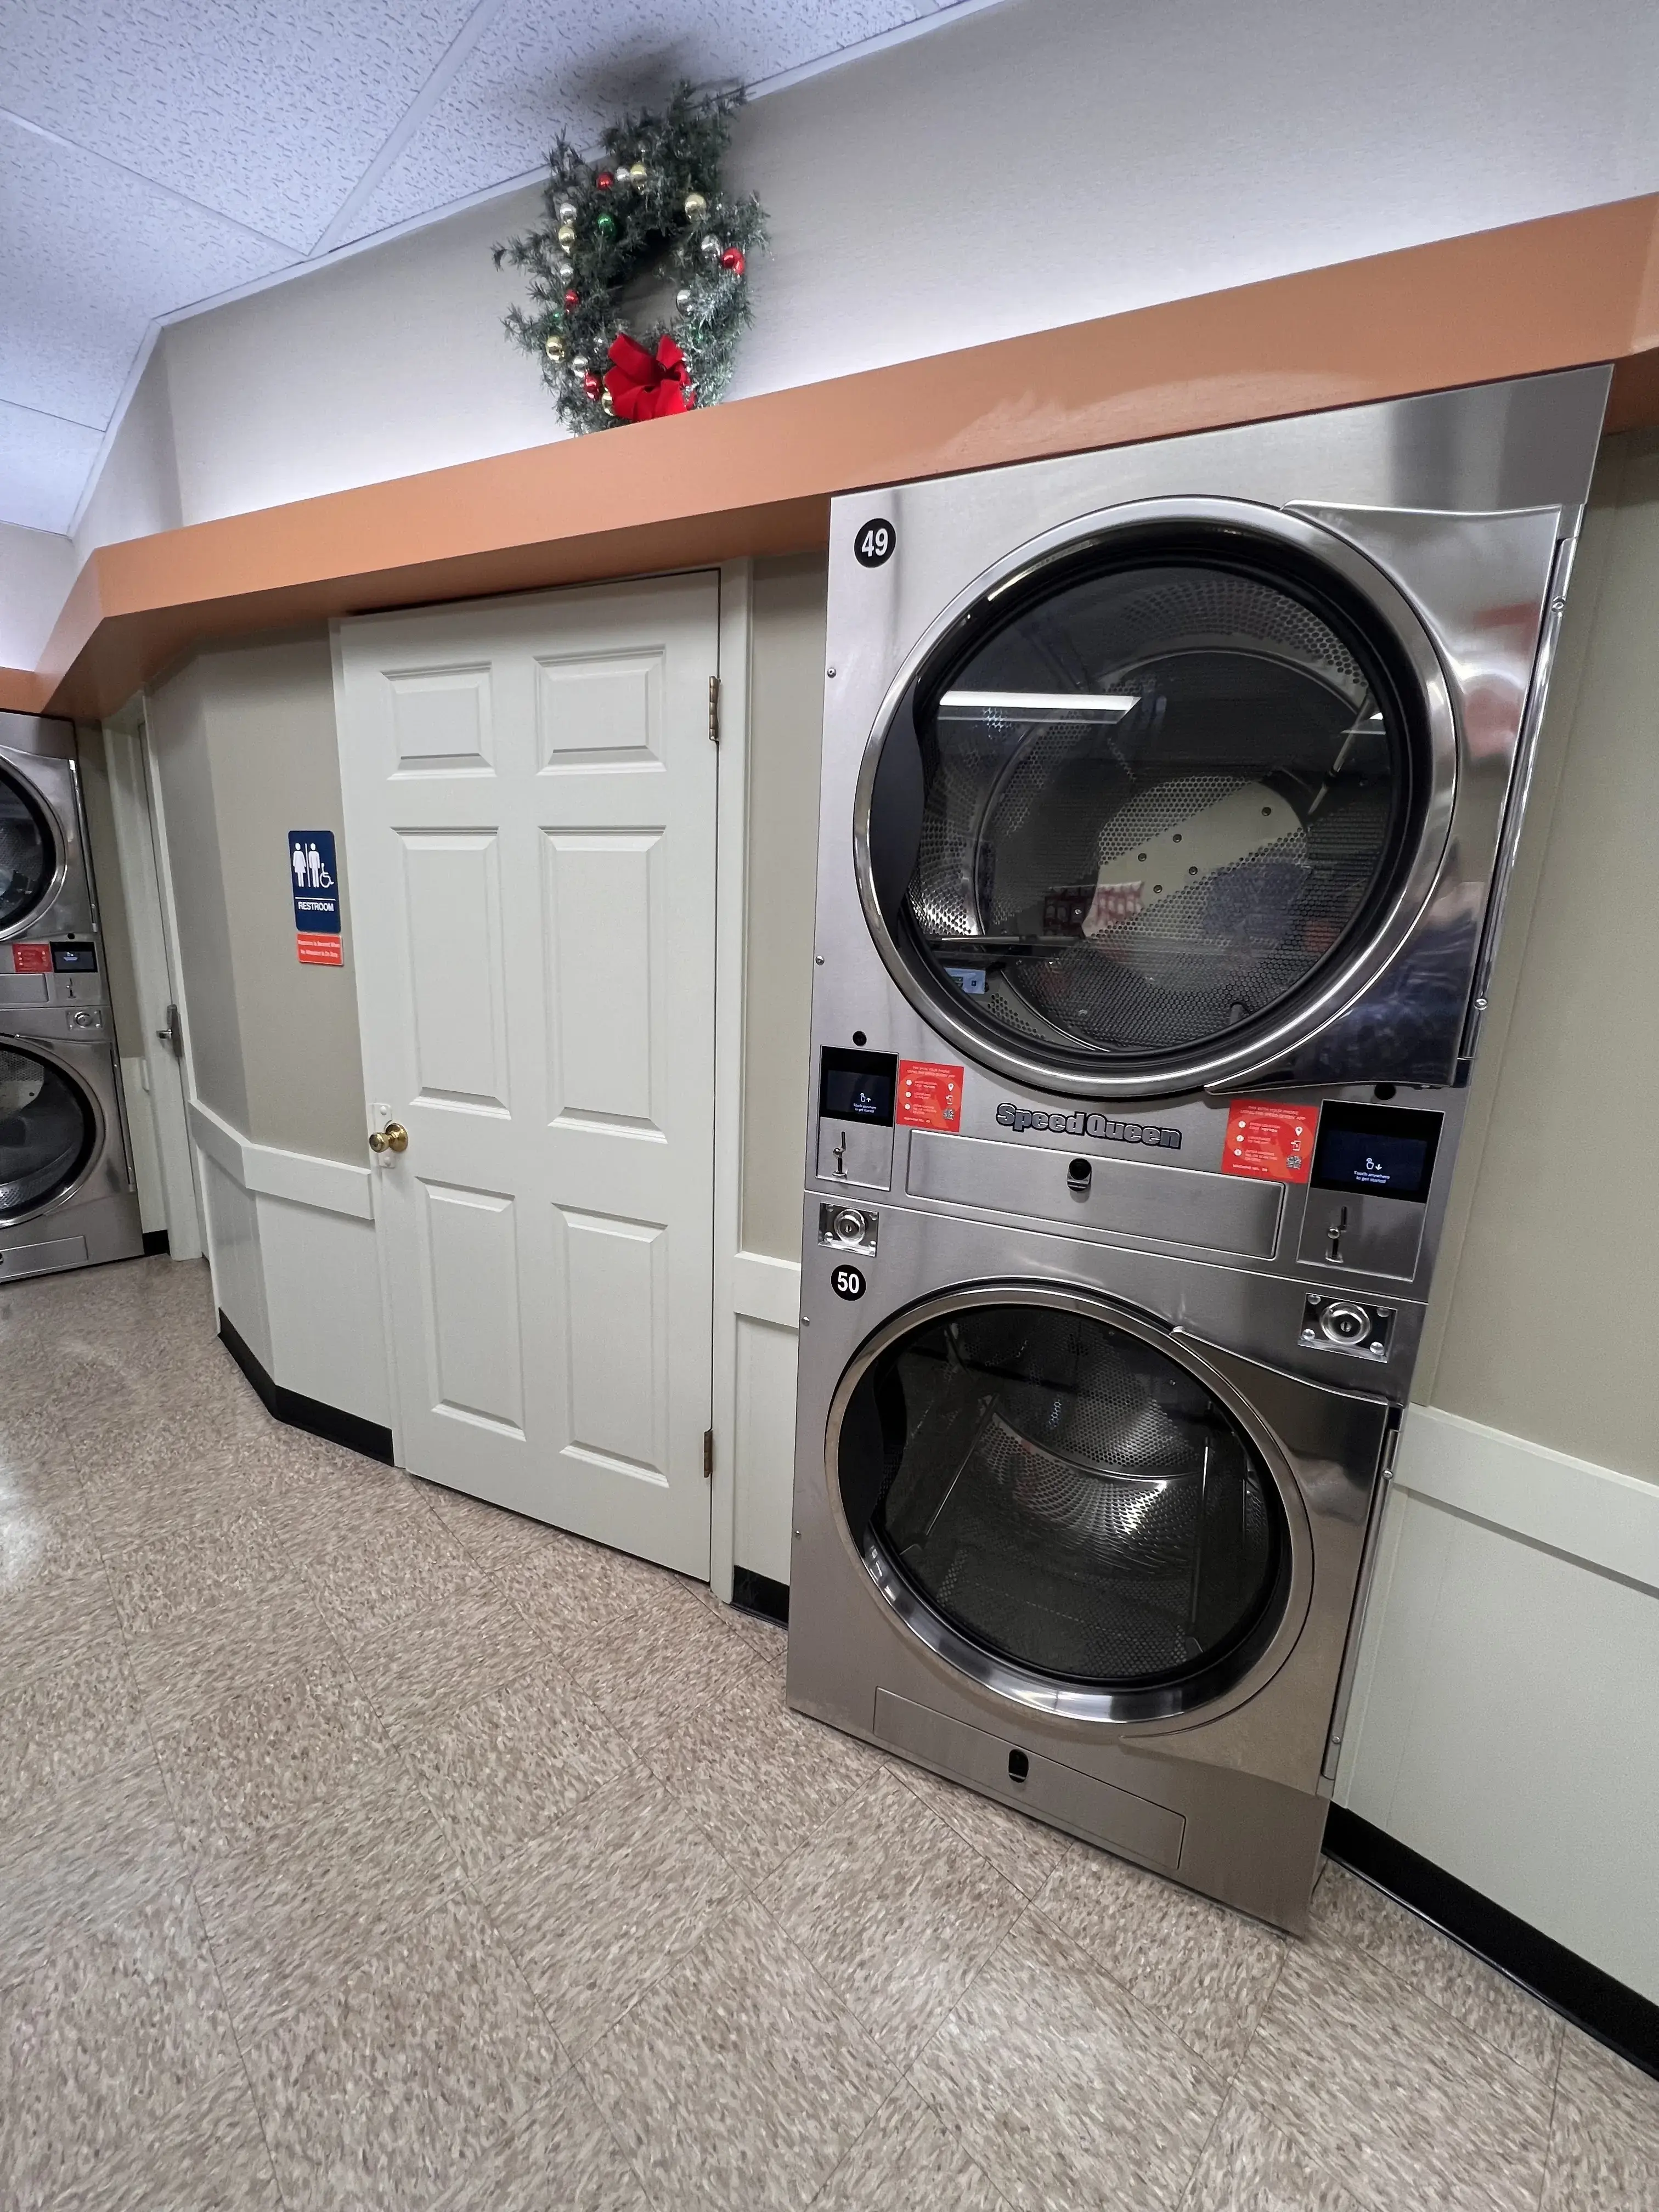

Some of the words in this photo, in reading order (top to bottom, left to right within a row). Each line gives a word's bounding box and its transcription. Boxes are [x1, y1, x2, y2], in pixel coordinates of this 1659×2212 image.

[861, 528, 888, 557] 49
[298, 901, 334, 911] RESTROOM
[996, 1102, 1087, 1136] Speed
[1086, 1113, 1182, 1149] Queen
[837, 1271, 860, 1294] 50
